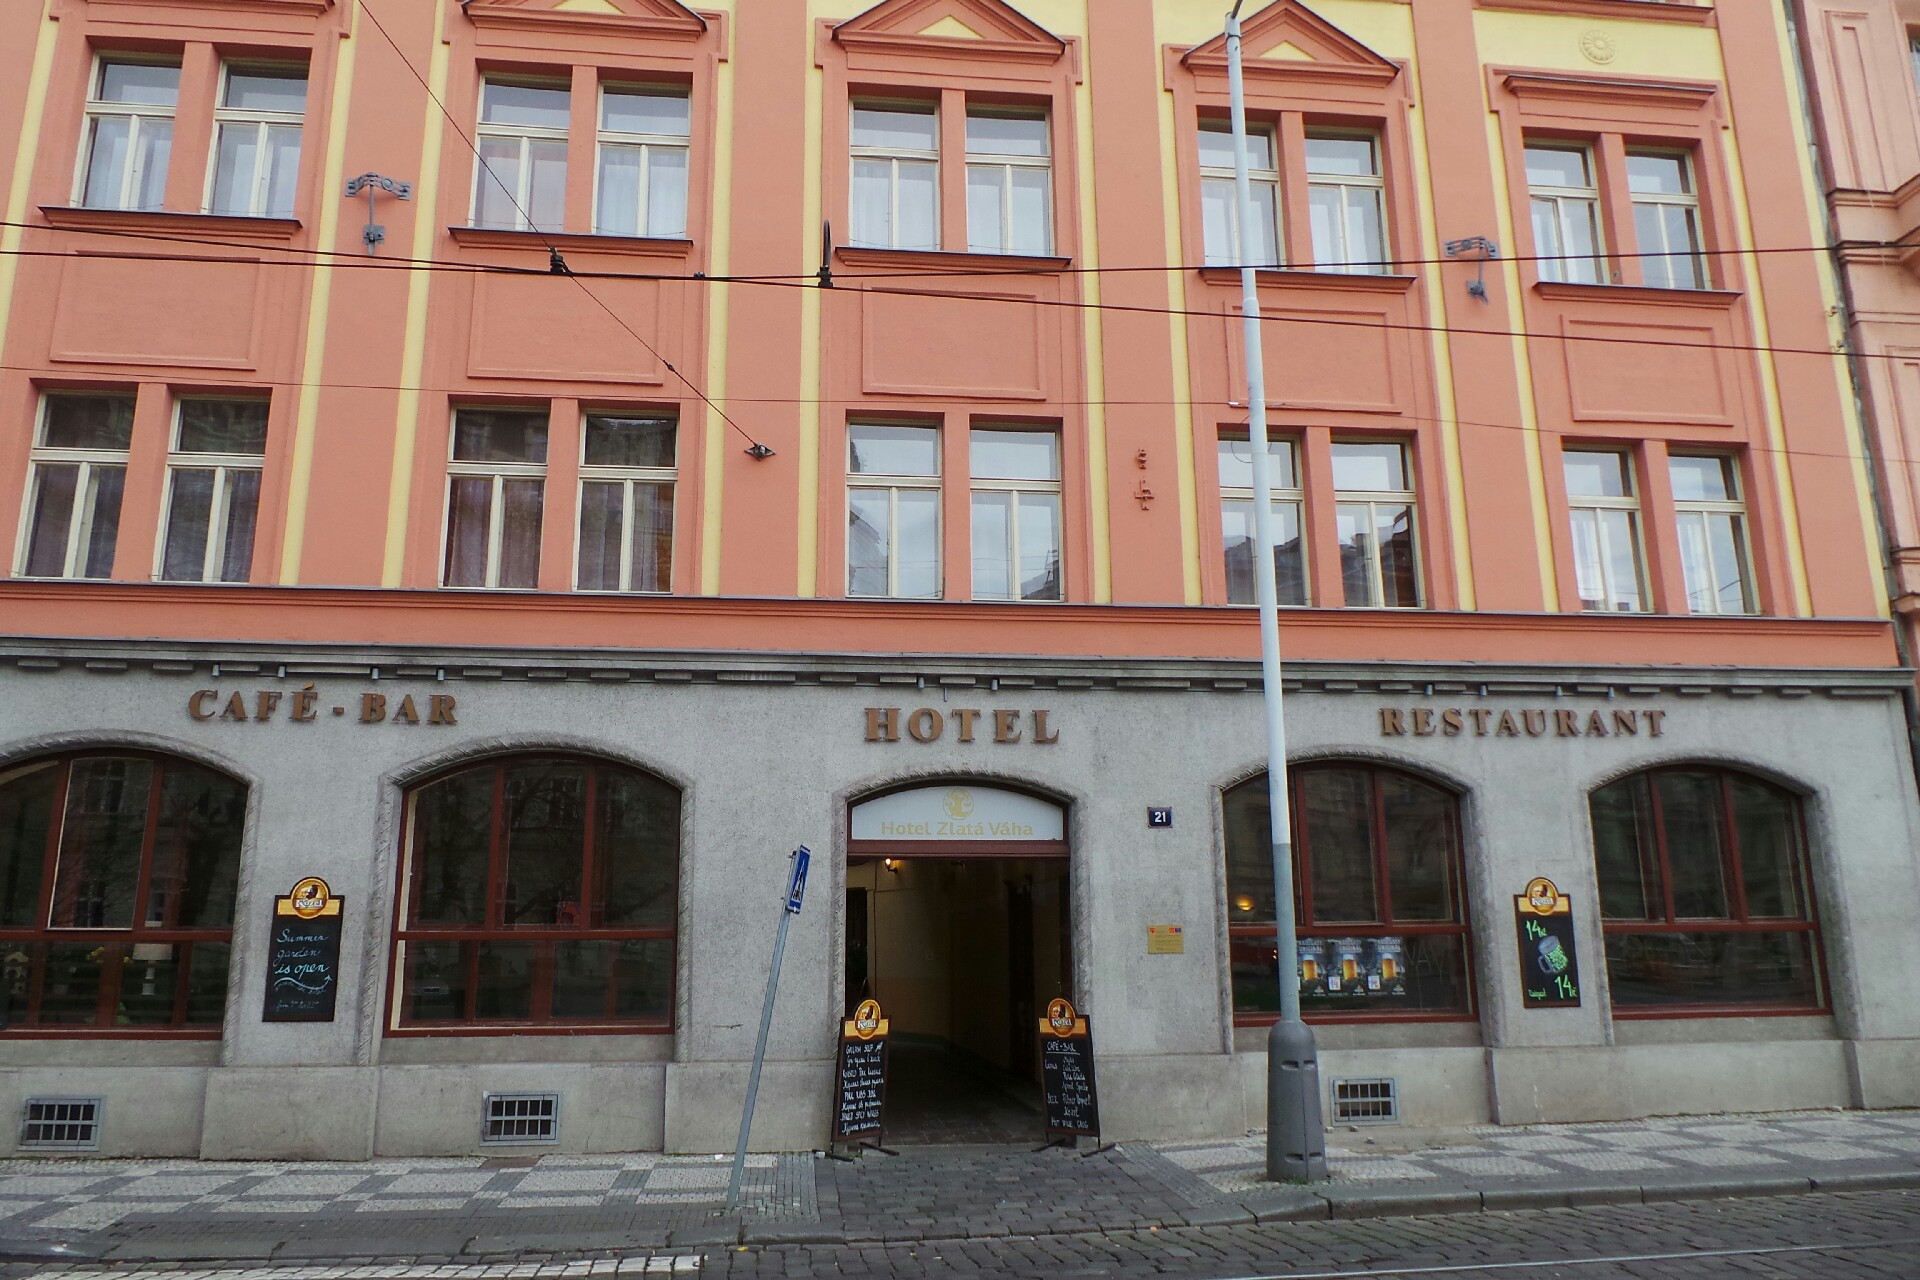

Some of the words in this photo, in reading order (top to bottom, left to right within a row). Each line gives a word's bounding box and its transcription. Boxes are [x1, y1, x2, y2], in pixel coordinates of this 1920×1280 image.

[358, 692, 458, 724] BAR
[864, 707, 1060, 743] HOTEL
[1379, 707, 1667, 737] RESTAURANT
[1154, 811, 1167, 823] 21
[881, 821, 932, 836] Hotel
[936, 821, 985, 836] Zlatá
[988, 821, 1034, 836] Váha
[277, 928, 329, 943] Summer
[272, 946, 321, 967] garden
[275, 963, 291, 975] is
[294, 962, 330, 980] open
[1051, 1018, 1072, 1027] Kozel
